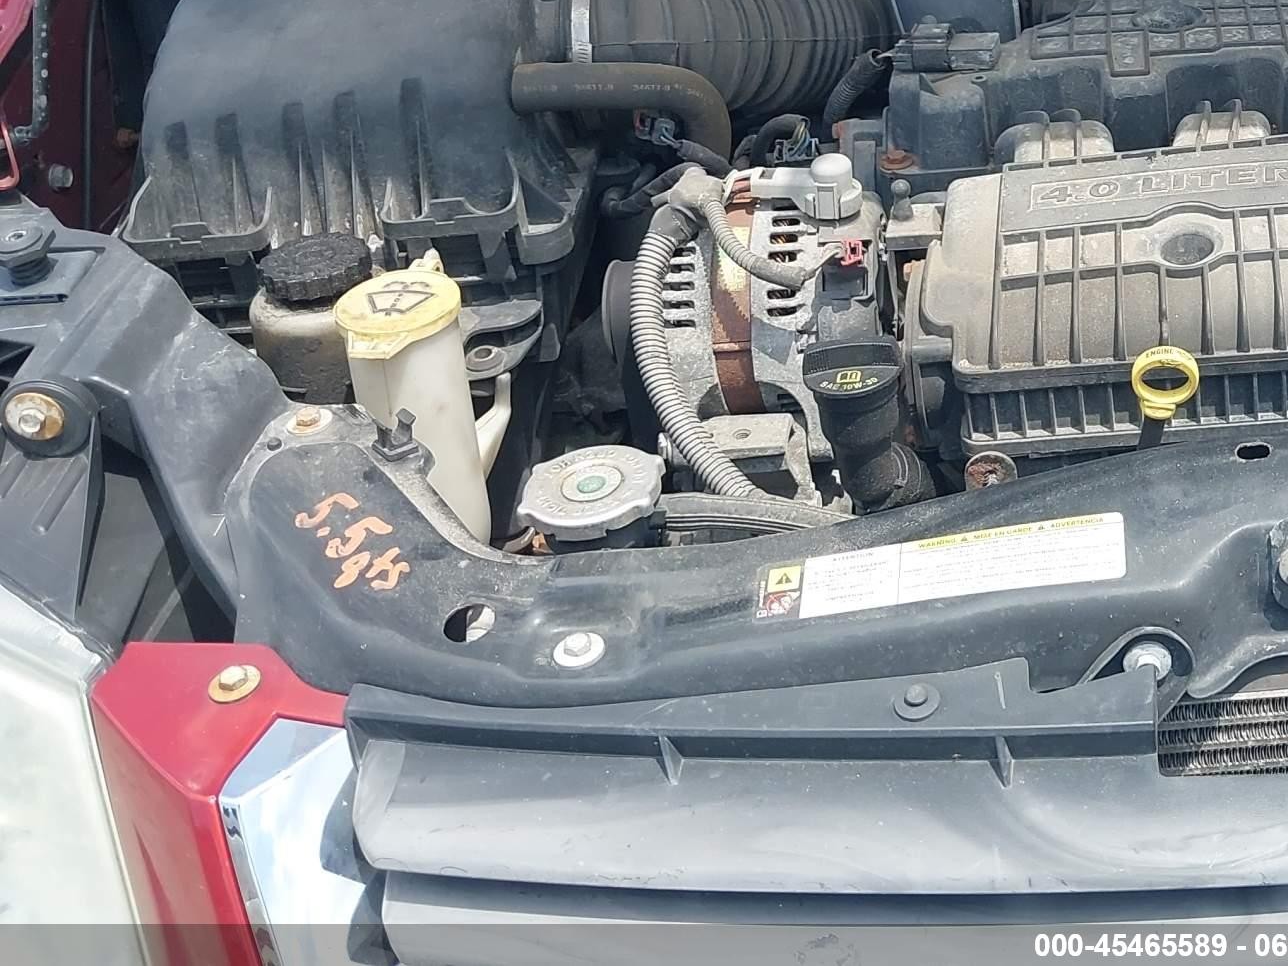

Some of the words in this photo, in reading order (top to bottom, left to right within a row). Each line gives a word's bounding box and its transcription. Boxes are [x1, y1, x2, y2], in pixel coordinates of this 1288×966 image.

[1039, 180, 1121, 205] 4.0
[1145, 348, 1173, 359] ENGINE
[819, 380, 841, 390] SAE
[841, 376, 879, 391] 10W-30
[918, 537, 957, 549] WARNING
[1050, 517, 1105, 529] ADVERTENCIA
